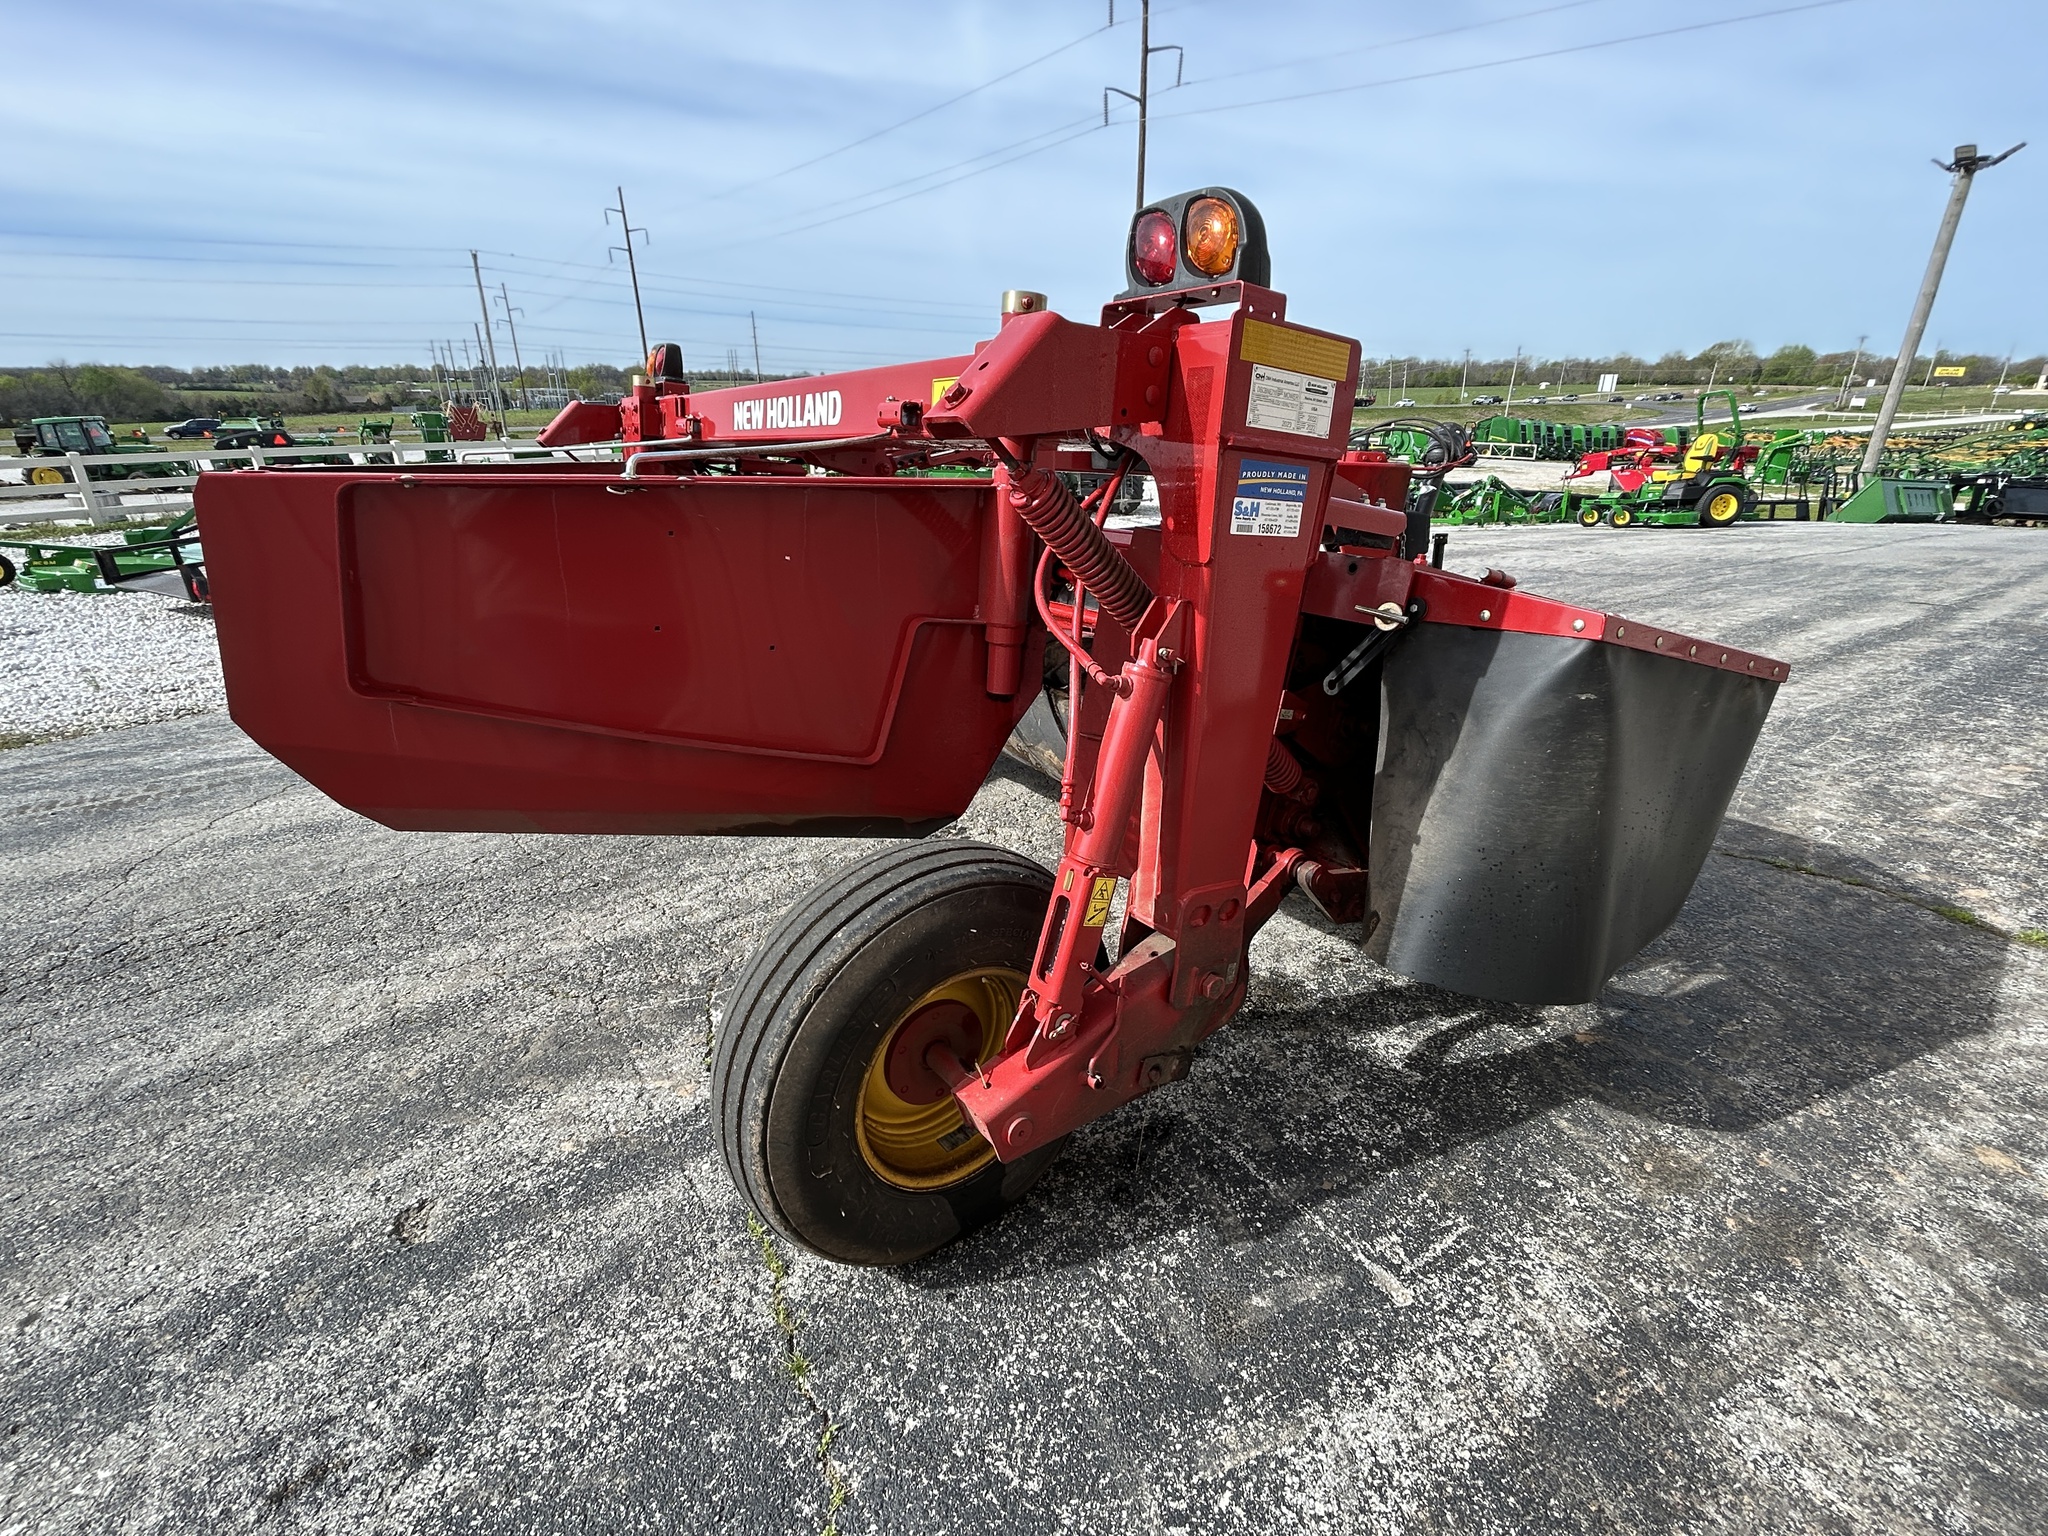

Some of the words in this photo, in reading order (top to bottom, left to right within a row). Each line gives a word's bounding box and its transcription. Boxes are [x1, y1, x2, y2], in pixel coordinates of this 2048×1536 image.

[733, 399, 764, 431] NEW
[766, 390, 842, 429] HOLLAND
[1260, 486, 1272, 494] NEW
[1234, 500, 1260, 518] S&H
[1258, 523, 1282, 535] 158672
